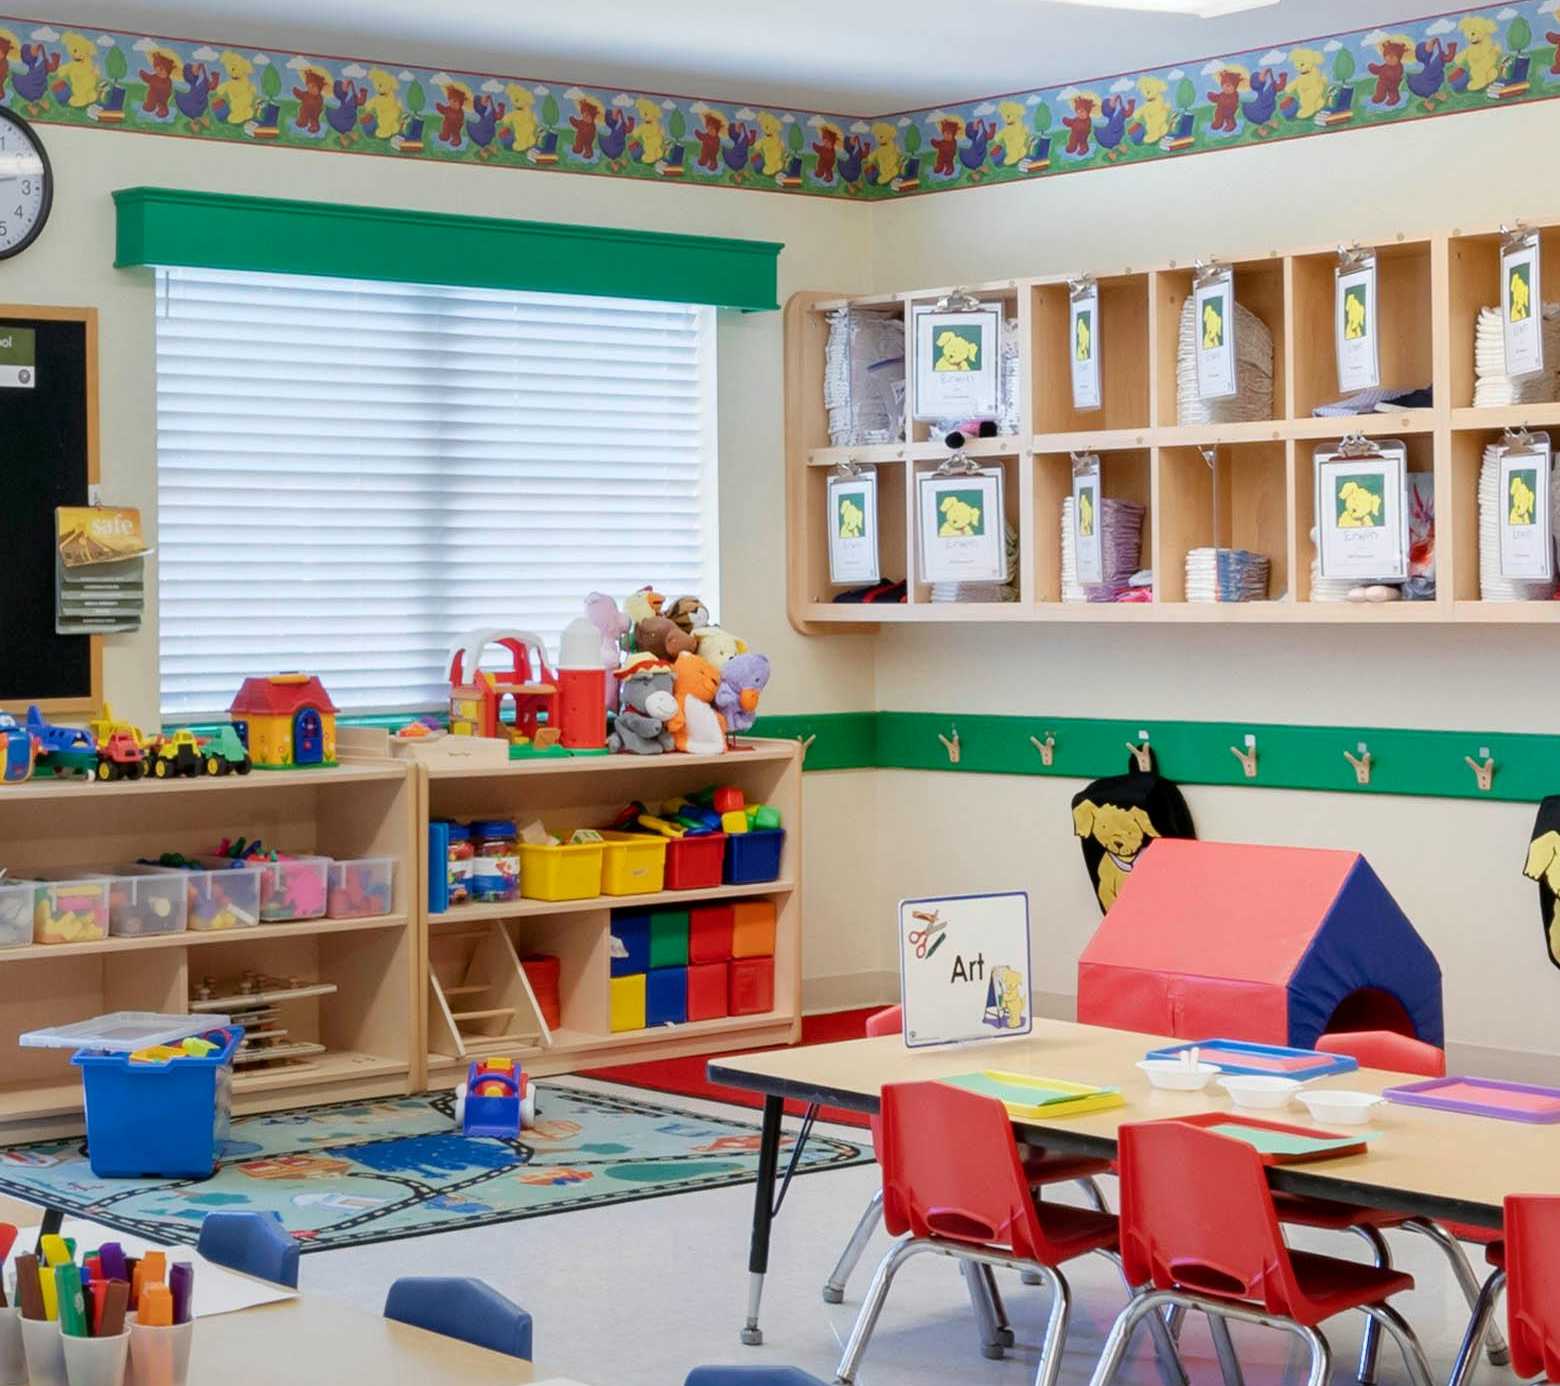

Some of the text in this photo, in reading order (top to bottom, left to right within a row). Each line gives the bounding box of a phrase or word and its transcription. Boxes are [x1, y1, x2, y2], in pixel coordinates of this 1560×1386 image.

[0, 136, 6, 151] 1
[22, 180, 31, 195] 3
[14, 204, 23, 219] 4
[92, 513, 133, 535] safe
[950, 952, 984, 983] Art
